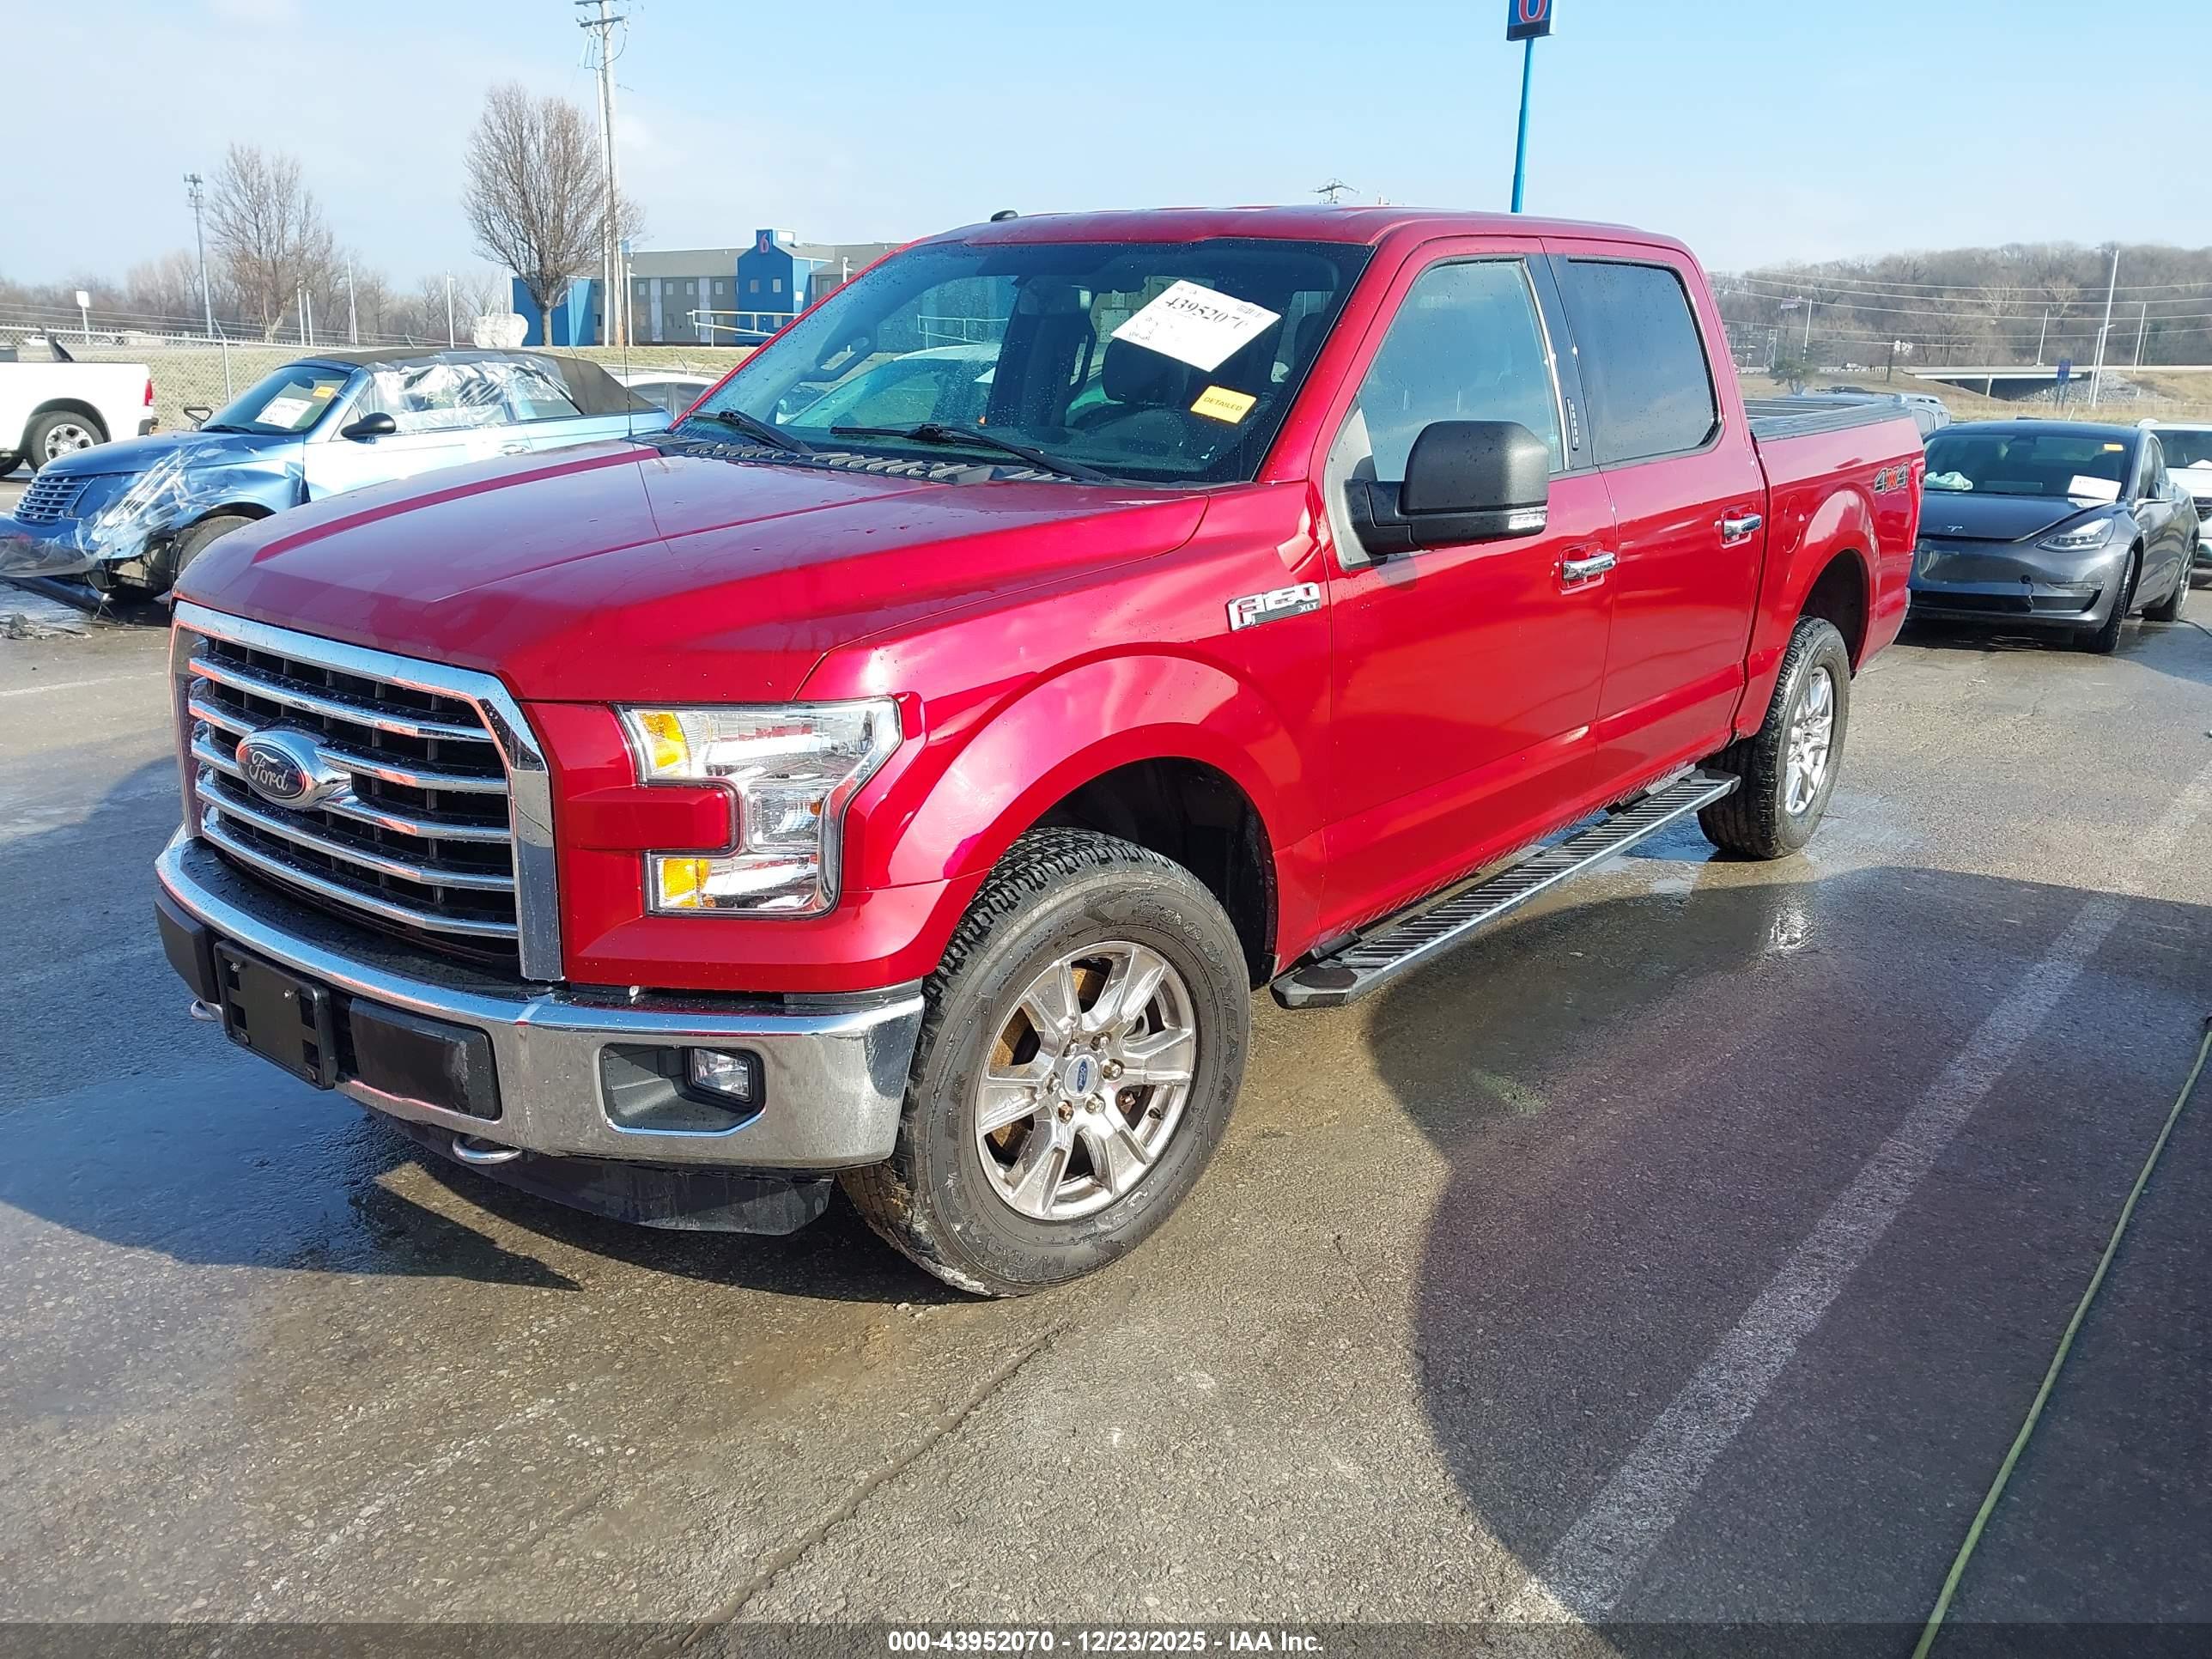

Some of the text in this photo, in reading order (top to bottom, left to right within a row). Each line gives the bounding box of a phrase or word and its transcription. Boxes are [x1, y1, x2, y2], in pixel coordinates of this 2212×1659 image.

[759, 234, 769, 253] 6
[1203, 398, 1243, 412] DETAILED
[1298, 602, 1319, 613] XLT
[248, 750, 289, 791] Ford
[1130, 899, 1239, 1104] GOODYEAR
